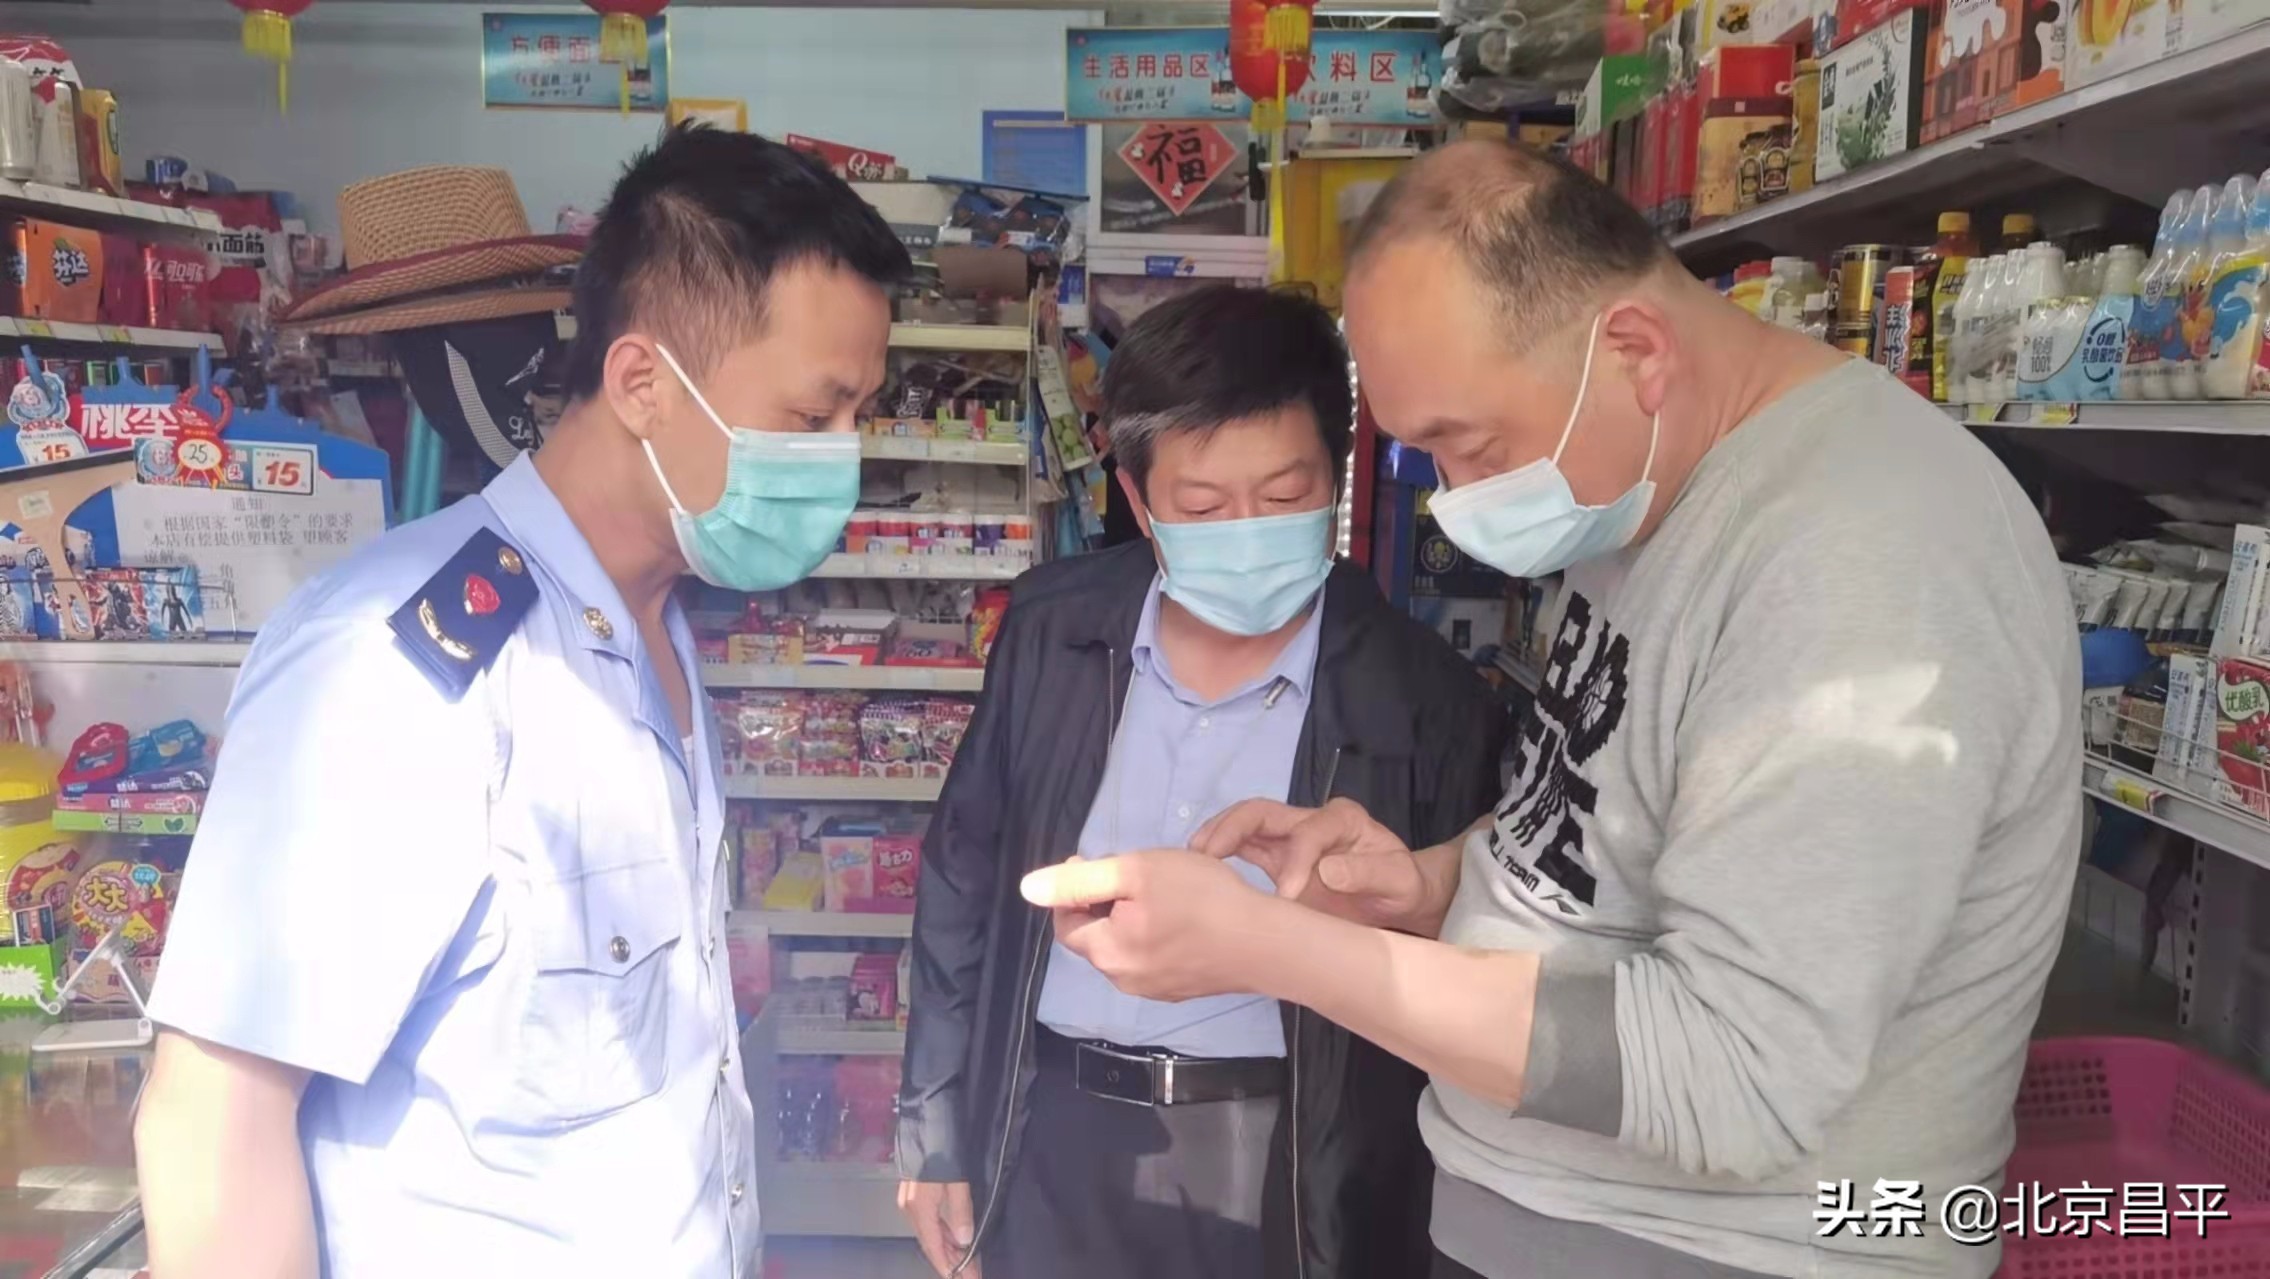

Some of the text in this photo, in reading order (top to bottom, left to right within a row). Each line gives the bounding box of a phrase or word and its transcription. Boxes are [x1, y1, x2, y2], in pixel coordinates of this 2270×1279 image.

[1083, 53, 1211, 79] 生活用品区
[1146, 124, 1207, 184] 福
[53, 249, 90, 278] 芬达
[2031, 356, 2052, 373] 100%
[2082, 347, 2124, 363] 乳酸菌饮品
[81, 402, 183, 441] 桃李
[42, 444, 71, 461] 15
[188, 443, 208, 464] 25
[265, 461, 301, 487] 15
[2225, 685, 2262, 713] 优酸乳
[84, 876, 129, 912] 大大
